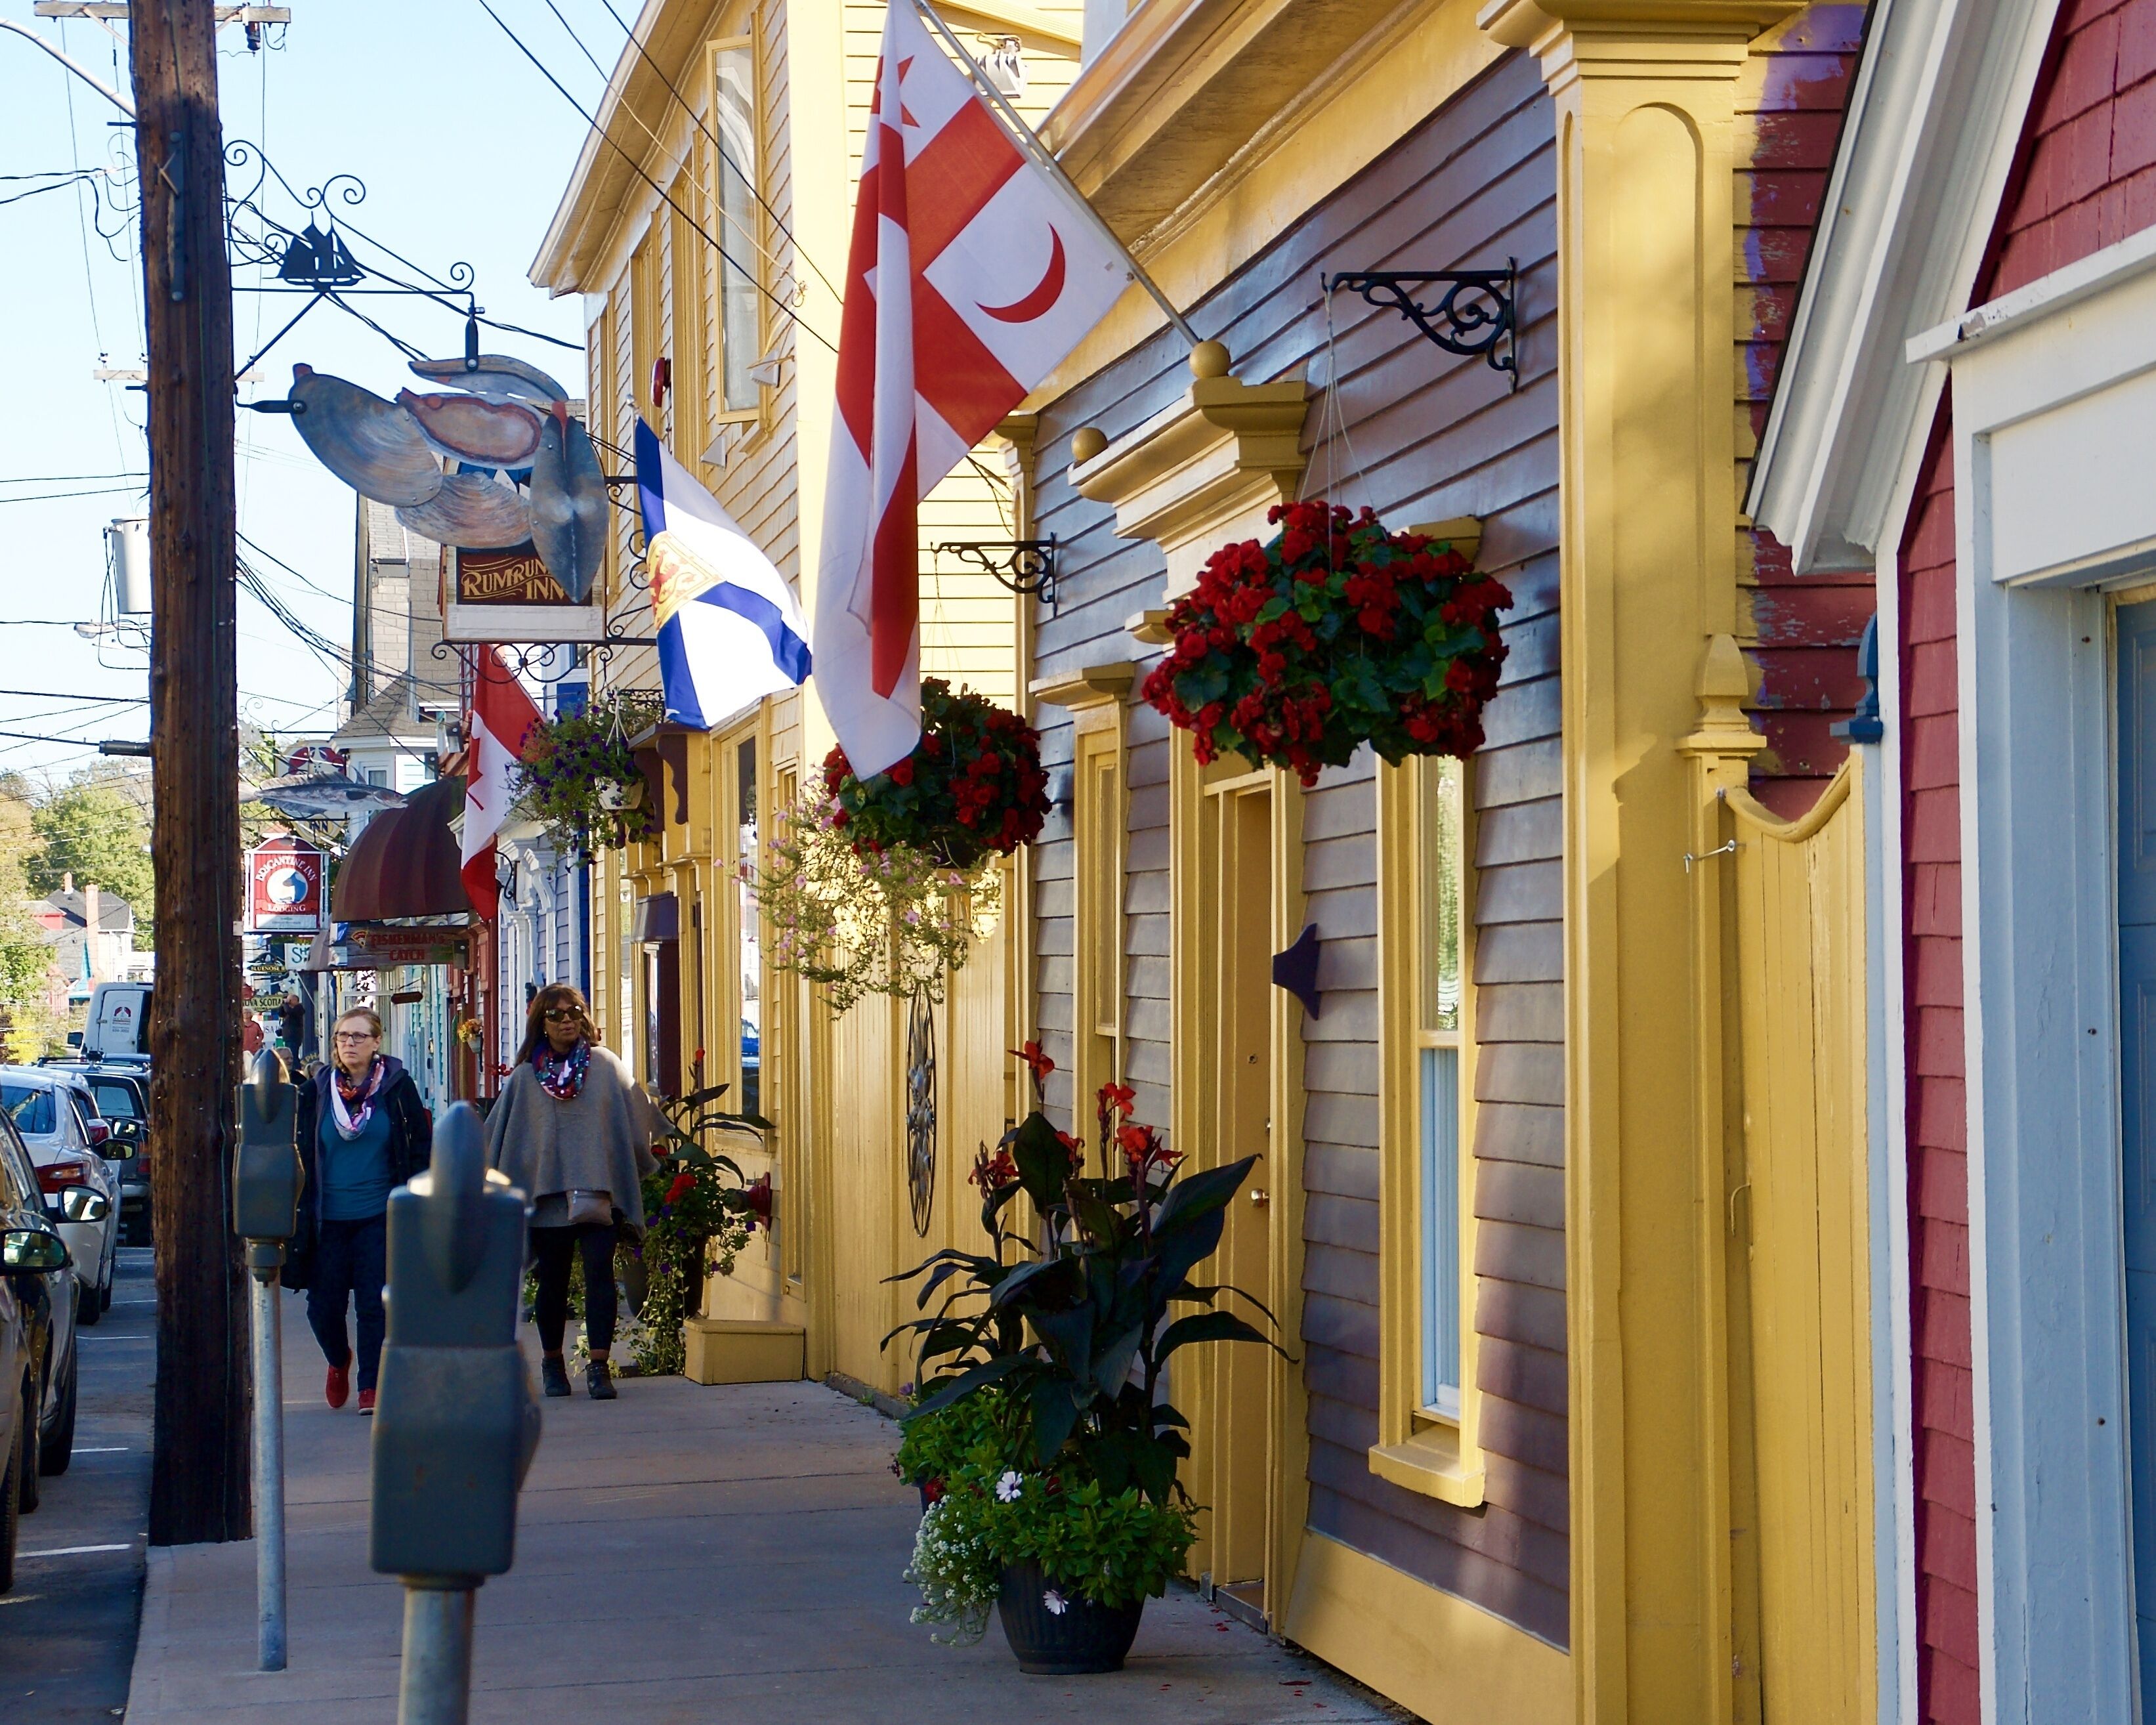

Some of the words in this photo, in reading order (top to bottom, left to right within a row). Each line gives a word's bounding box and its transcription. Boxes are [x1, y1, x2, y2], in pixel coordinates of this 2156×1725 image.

[461, 559, 550, 596] RUMRUN
[526, 577, 564, 599] INN
[255, 855, 305, 882] BRIGANTINE
[303, 866, 317, 881] INN
[268, 904, 306, 912] LODGING
[390, 949, 425, 961] CATCH
